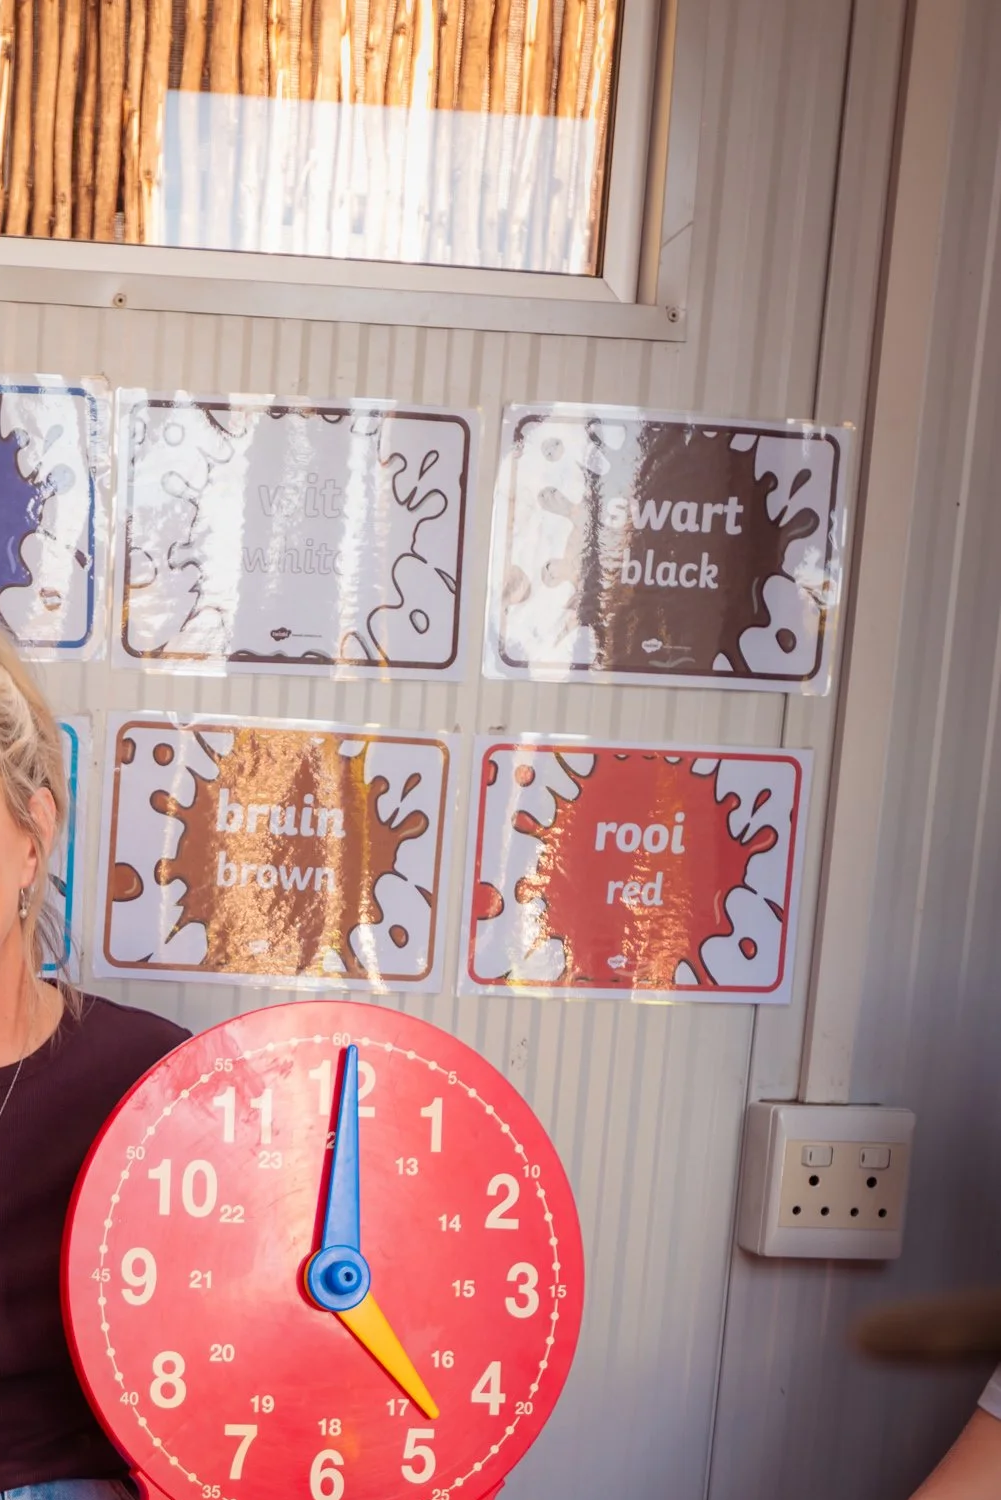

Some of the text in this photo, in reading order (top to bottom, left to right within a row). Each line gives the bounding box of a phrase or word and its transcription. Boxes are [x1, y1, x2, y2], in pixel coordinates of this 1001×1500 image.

[604, 496, 744, 535] swart
[620, 549, 719, 589] black
[216, 788, 346, 838] bruin
[595, 812, 685, 854] rooi
[216, 850, 336, 894] brown
[606, 871, 664, 906] red
[332, 1033, 351, 1046] 60
[215, 1058, 233, 1072] 55
[448, 1071, 457, 1085] 5
[309, 1059, 376, 1117] 12
[212, 1086, 273, 1144] 11
[421, 1098, 442, 1152] 1
[127, 1146, 145, 1160] 50
[259, 1151, 283, 1169] 23
[396, 1158, 418, 1175] 13
[523, 1165, 540, 1178] 10
[148, 1159, 217, 1217] 10
[485, 1174, 519, 1229] 2
[220, 1205, 244, 1223] 22
[439, 1214, 461, 1231] 14
[91, 1268, 110, 1282] 45
[122, 1248, 156, 1305] 9
[190, 1270, 211, 1288] 21
[452, 1280, 475, 1297] 15
[505, 1262, 539, 1318] 3
[550, 1285, 566, 1298] 15
[210, 1344, 234, 1361] 20
[432, 1351, 454, 1368] 16
[150, 1351, 186, 1408] 8
[471, 1361, 505, 1415] 4
[120, 1392, 138, 1405] 40
[251, 1395, 274, 1413] 19
[387, 1399, 409, 1416] 17
[515, 1402, 533, 1415] 20
[319, 1419, 341, 1436] 18
[225, 1424, 257, 1479] 7
[402, 1428, 435, 1483] 5
[202, 1485, 220, 1498] 35
